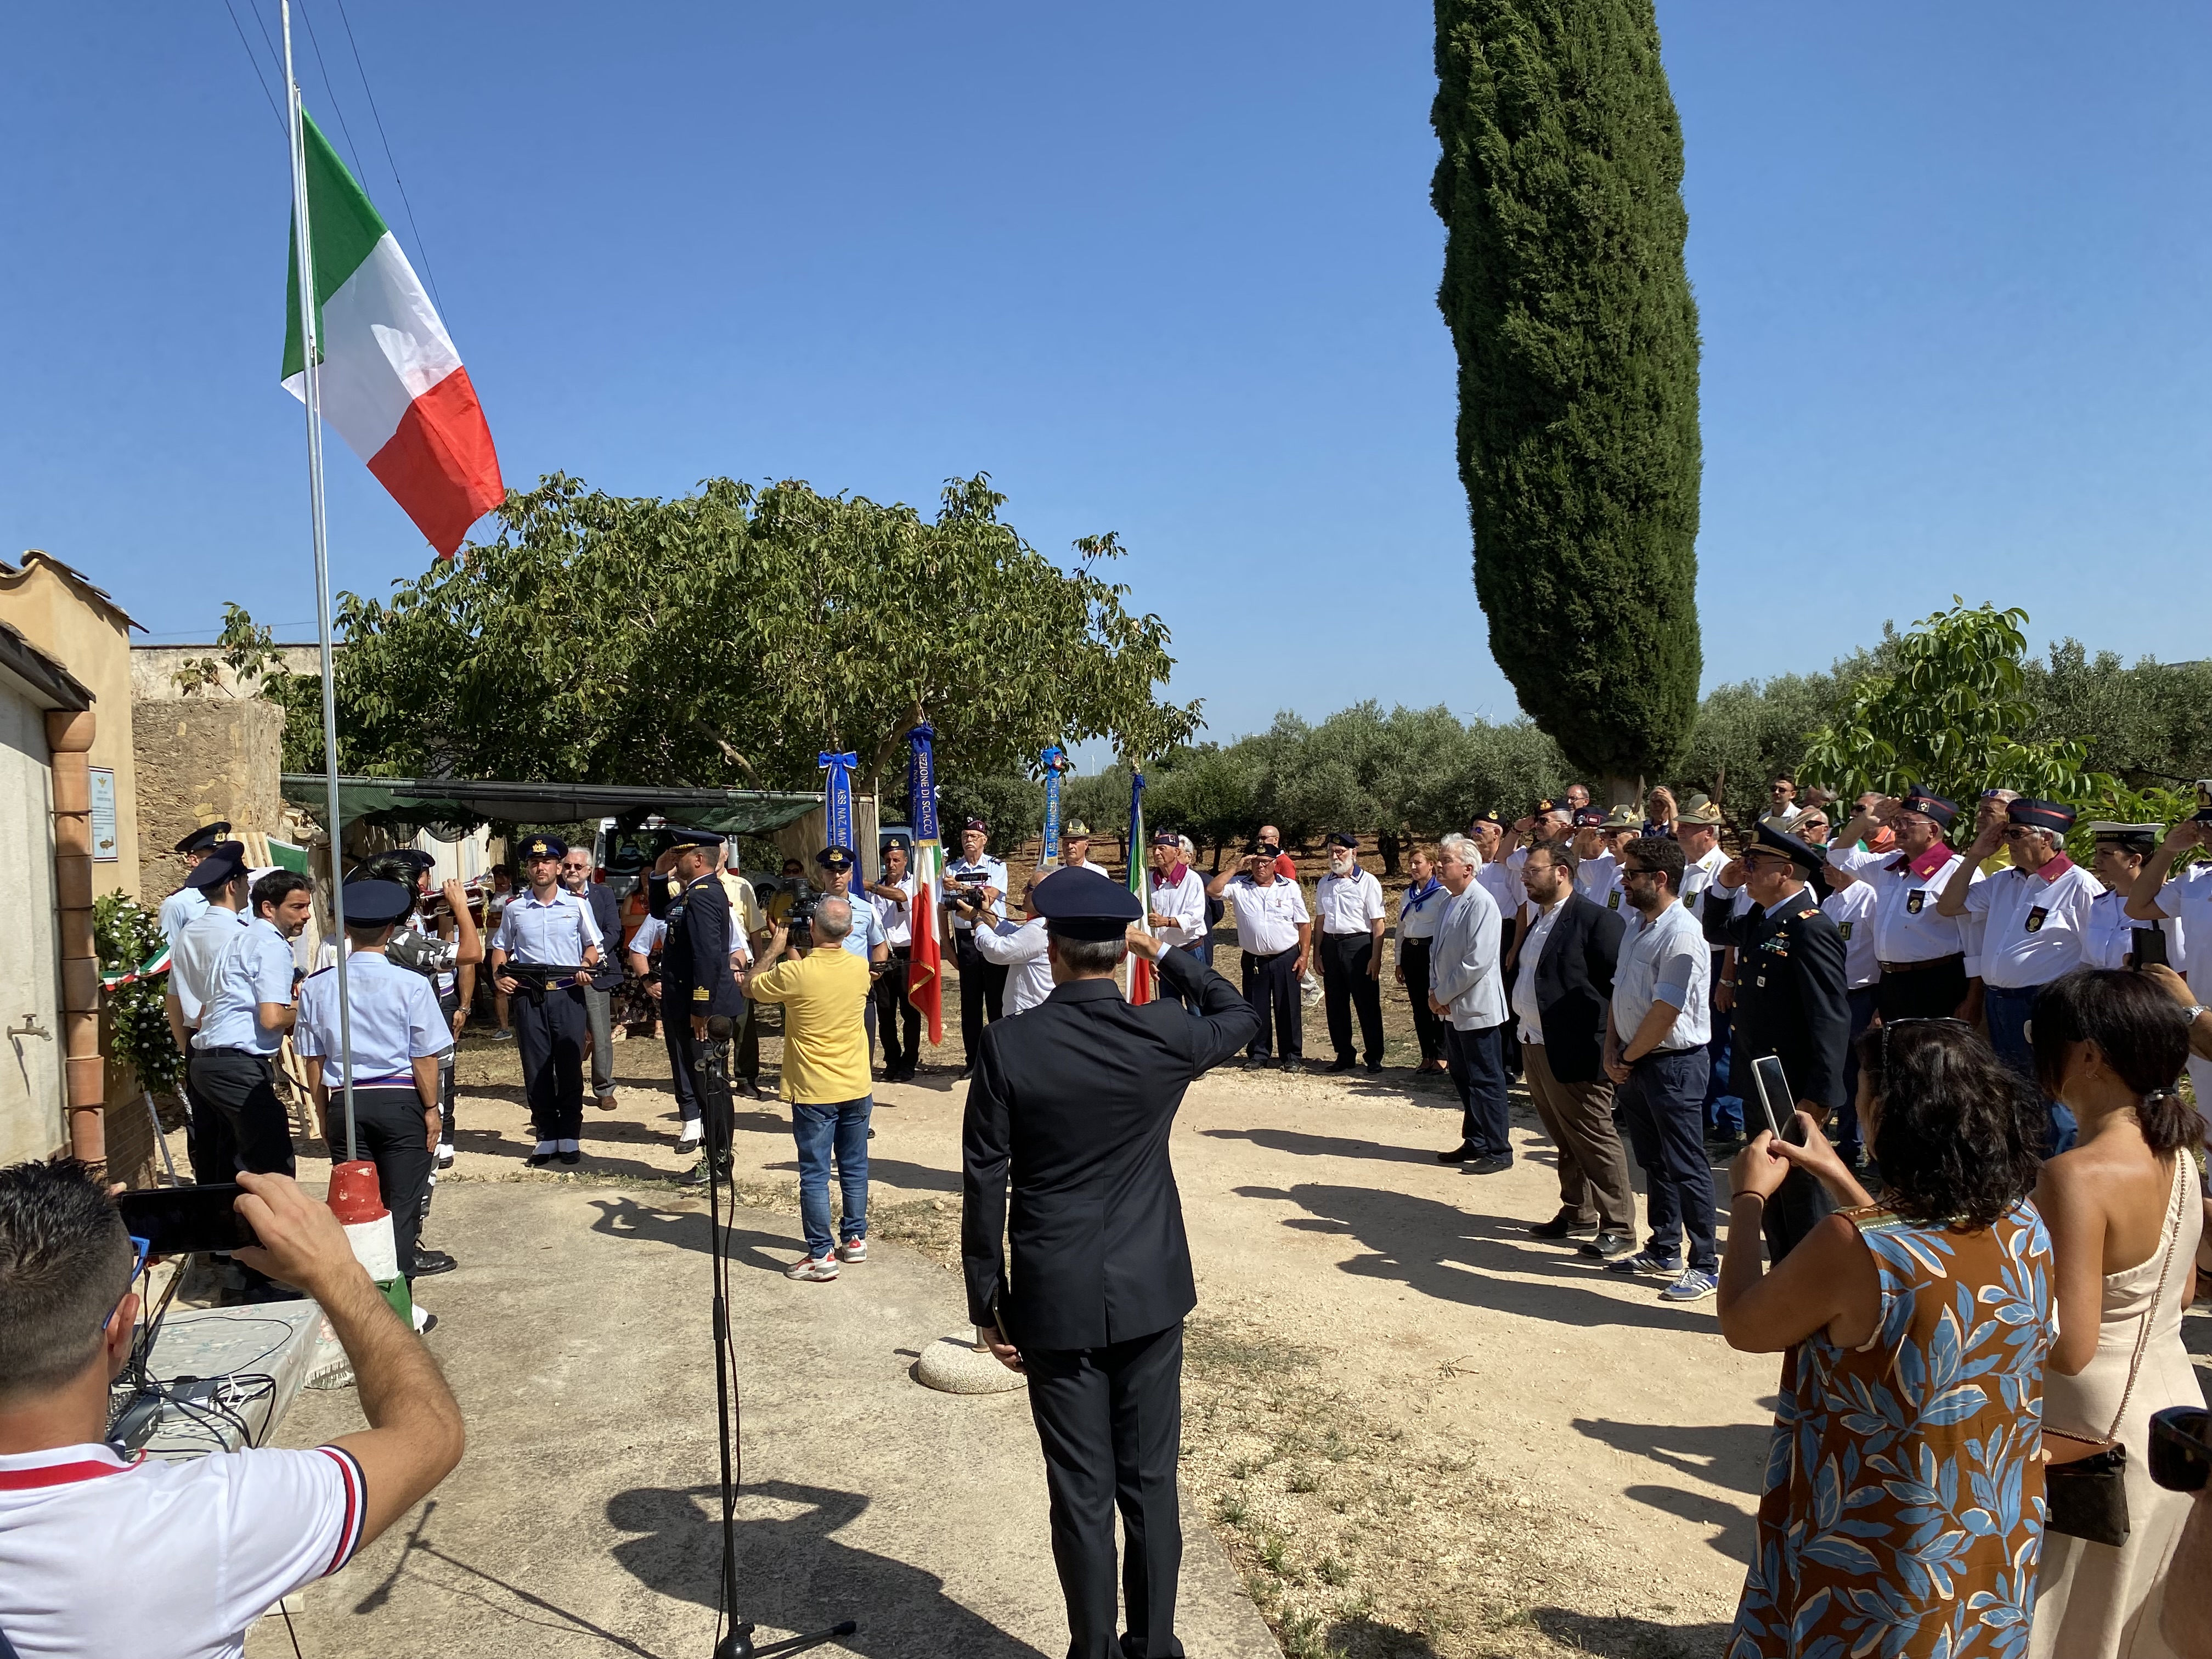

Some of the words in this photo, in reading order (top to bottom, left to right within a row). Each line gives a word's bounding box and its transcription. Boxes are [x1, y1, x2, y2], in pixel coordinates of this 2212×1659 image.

[919, 752, 929, 788] SEZIONE
[921, 789, 930, 799] DI
[837, 807, 847, 826] NAZ
[922, 801, 933, 836] SCIACCA
[837, 827, 848, 848] MAR
